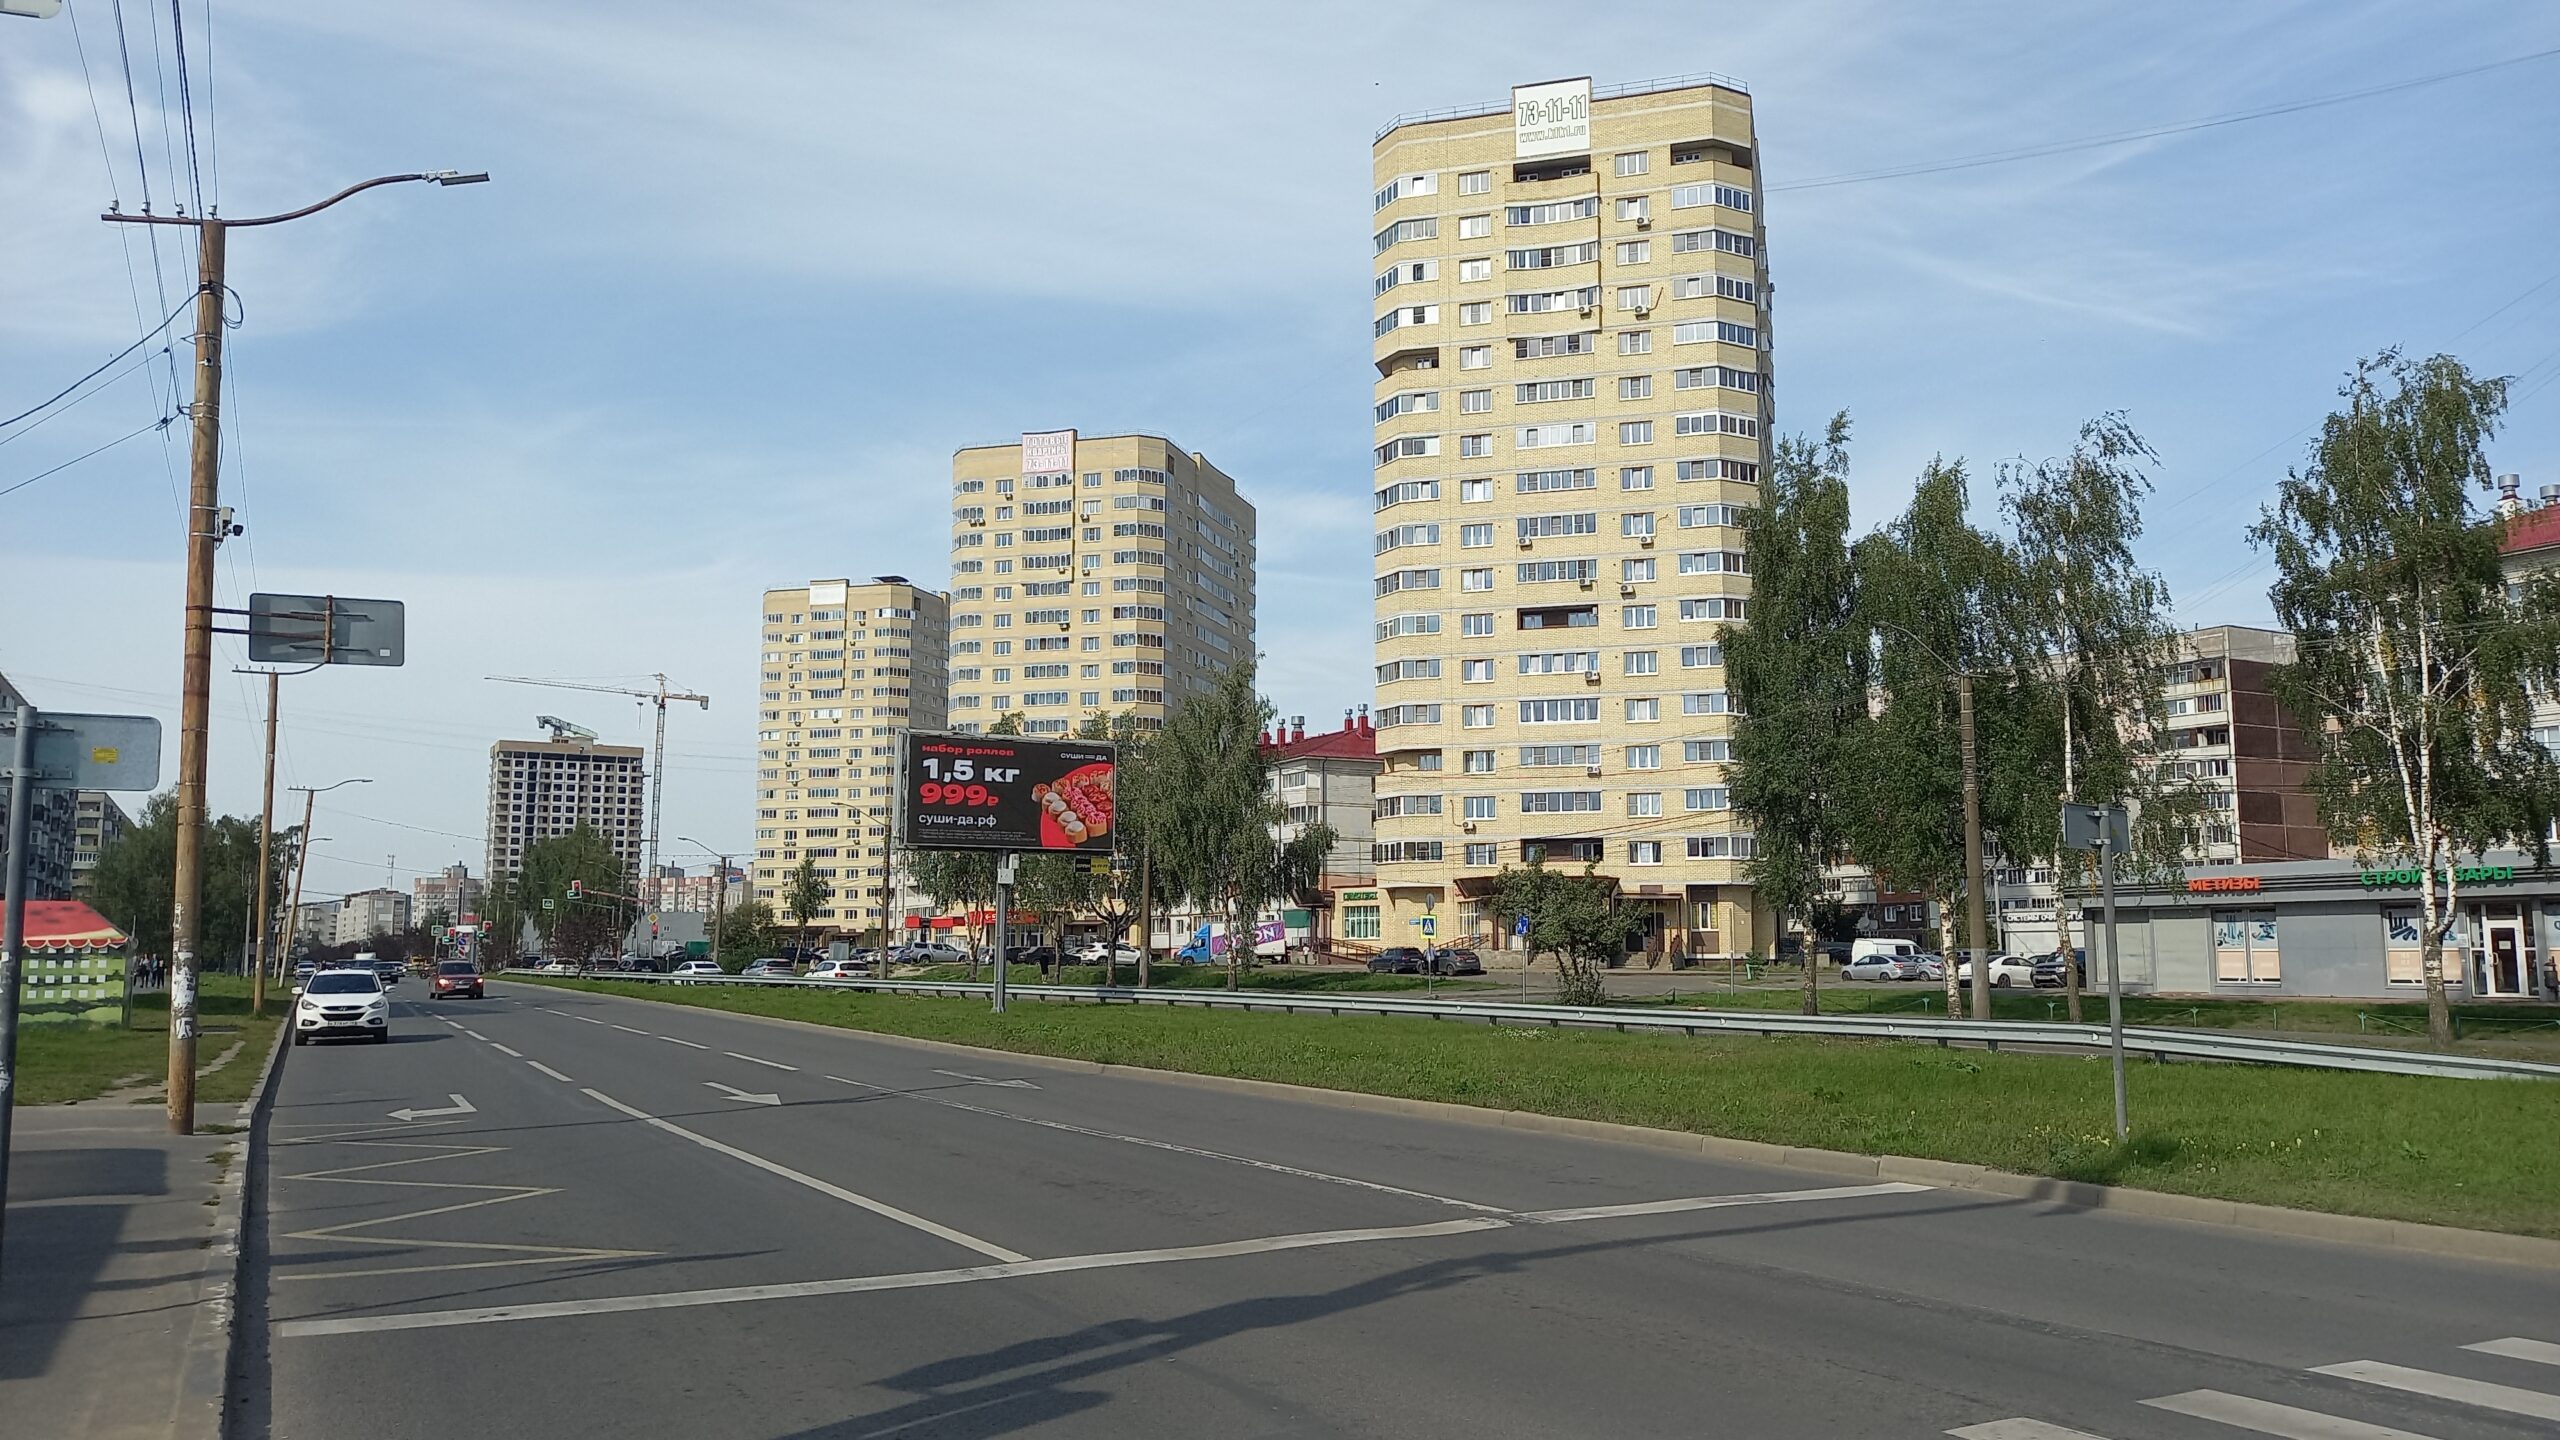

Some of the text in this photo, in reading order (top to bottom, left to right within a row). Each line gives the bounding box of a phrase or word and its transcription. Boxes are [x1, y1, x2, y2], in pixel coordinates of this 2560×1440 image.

[1518, 94, 1587, 126] 73-11-11
[1026, 435, 1068, 447] ГОТОВЫЕ
[1026, 445, 1068, 457] КВАРТИРЫ
[1026, 456, 1068, 470] 73-11-11
[921, 744, 1015, 756] набор роллов
[922, 758, 1020, 783] 1,5 кг
[918, 814, 997, 828] суши-да.рф
[2360, 865, 2513, 886] СТРОЙОВАРЫ
[2188, 877, 2261, 892] МЕТИЗЫ
